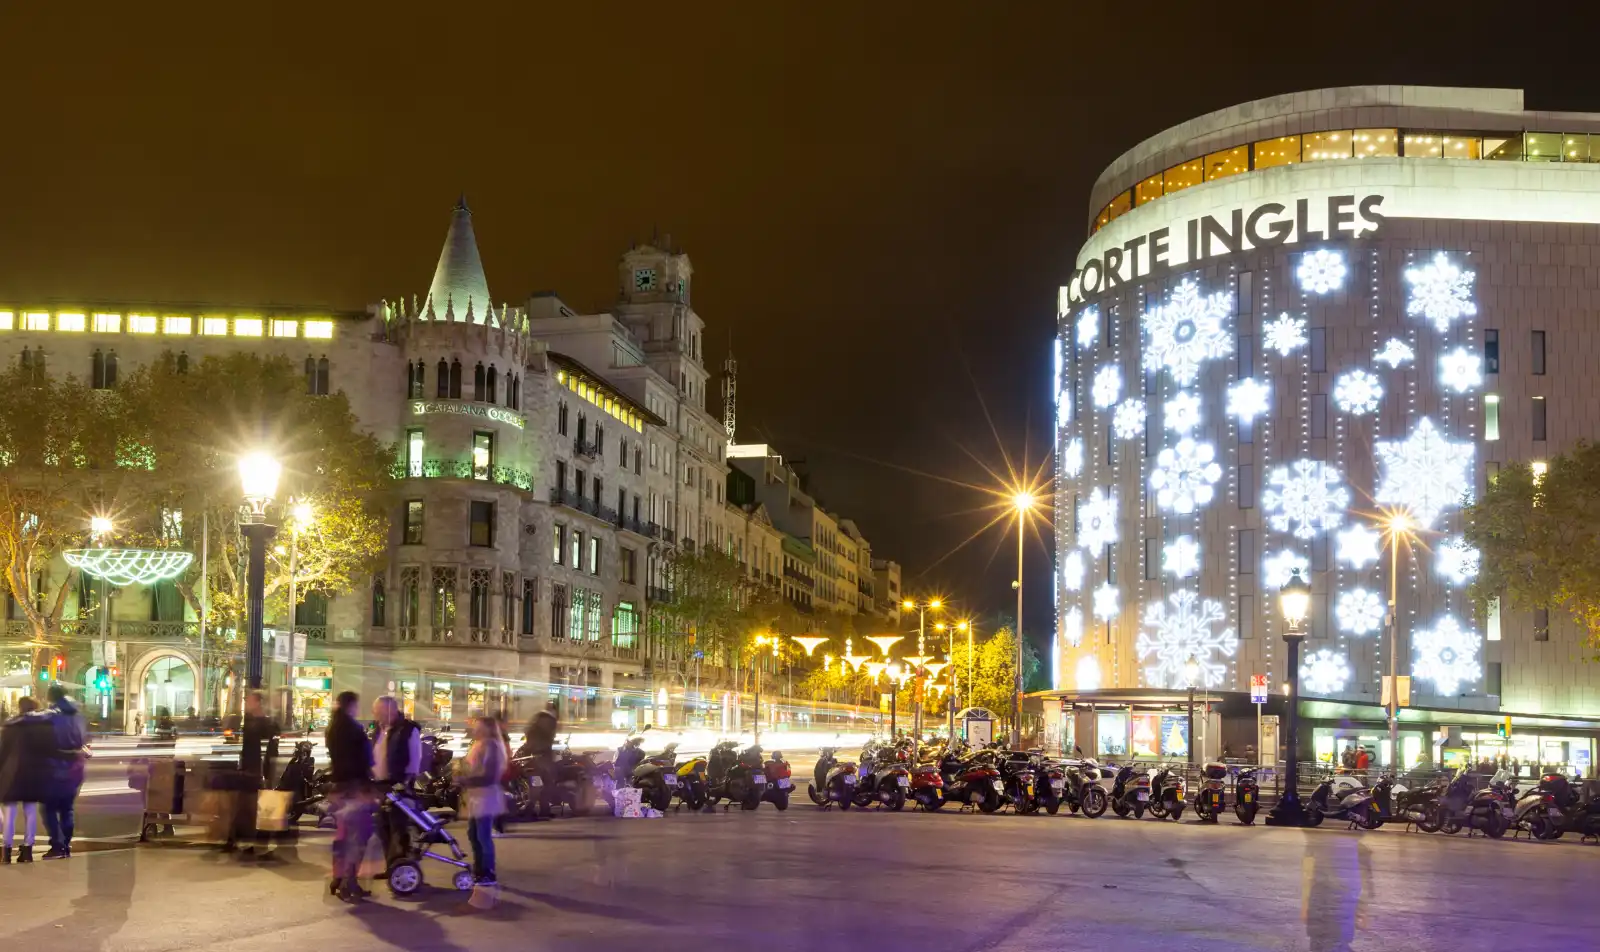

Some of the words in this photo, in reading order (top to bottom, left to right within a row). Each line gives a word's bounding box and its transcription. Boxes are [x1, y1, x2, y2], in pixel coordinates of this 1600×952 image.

[1068, 227, 1170, 304] CORTE
[1187, 194, 1385, 260] INGLES
[424, 403, 487, 417] CATALANA
